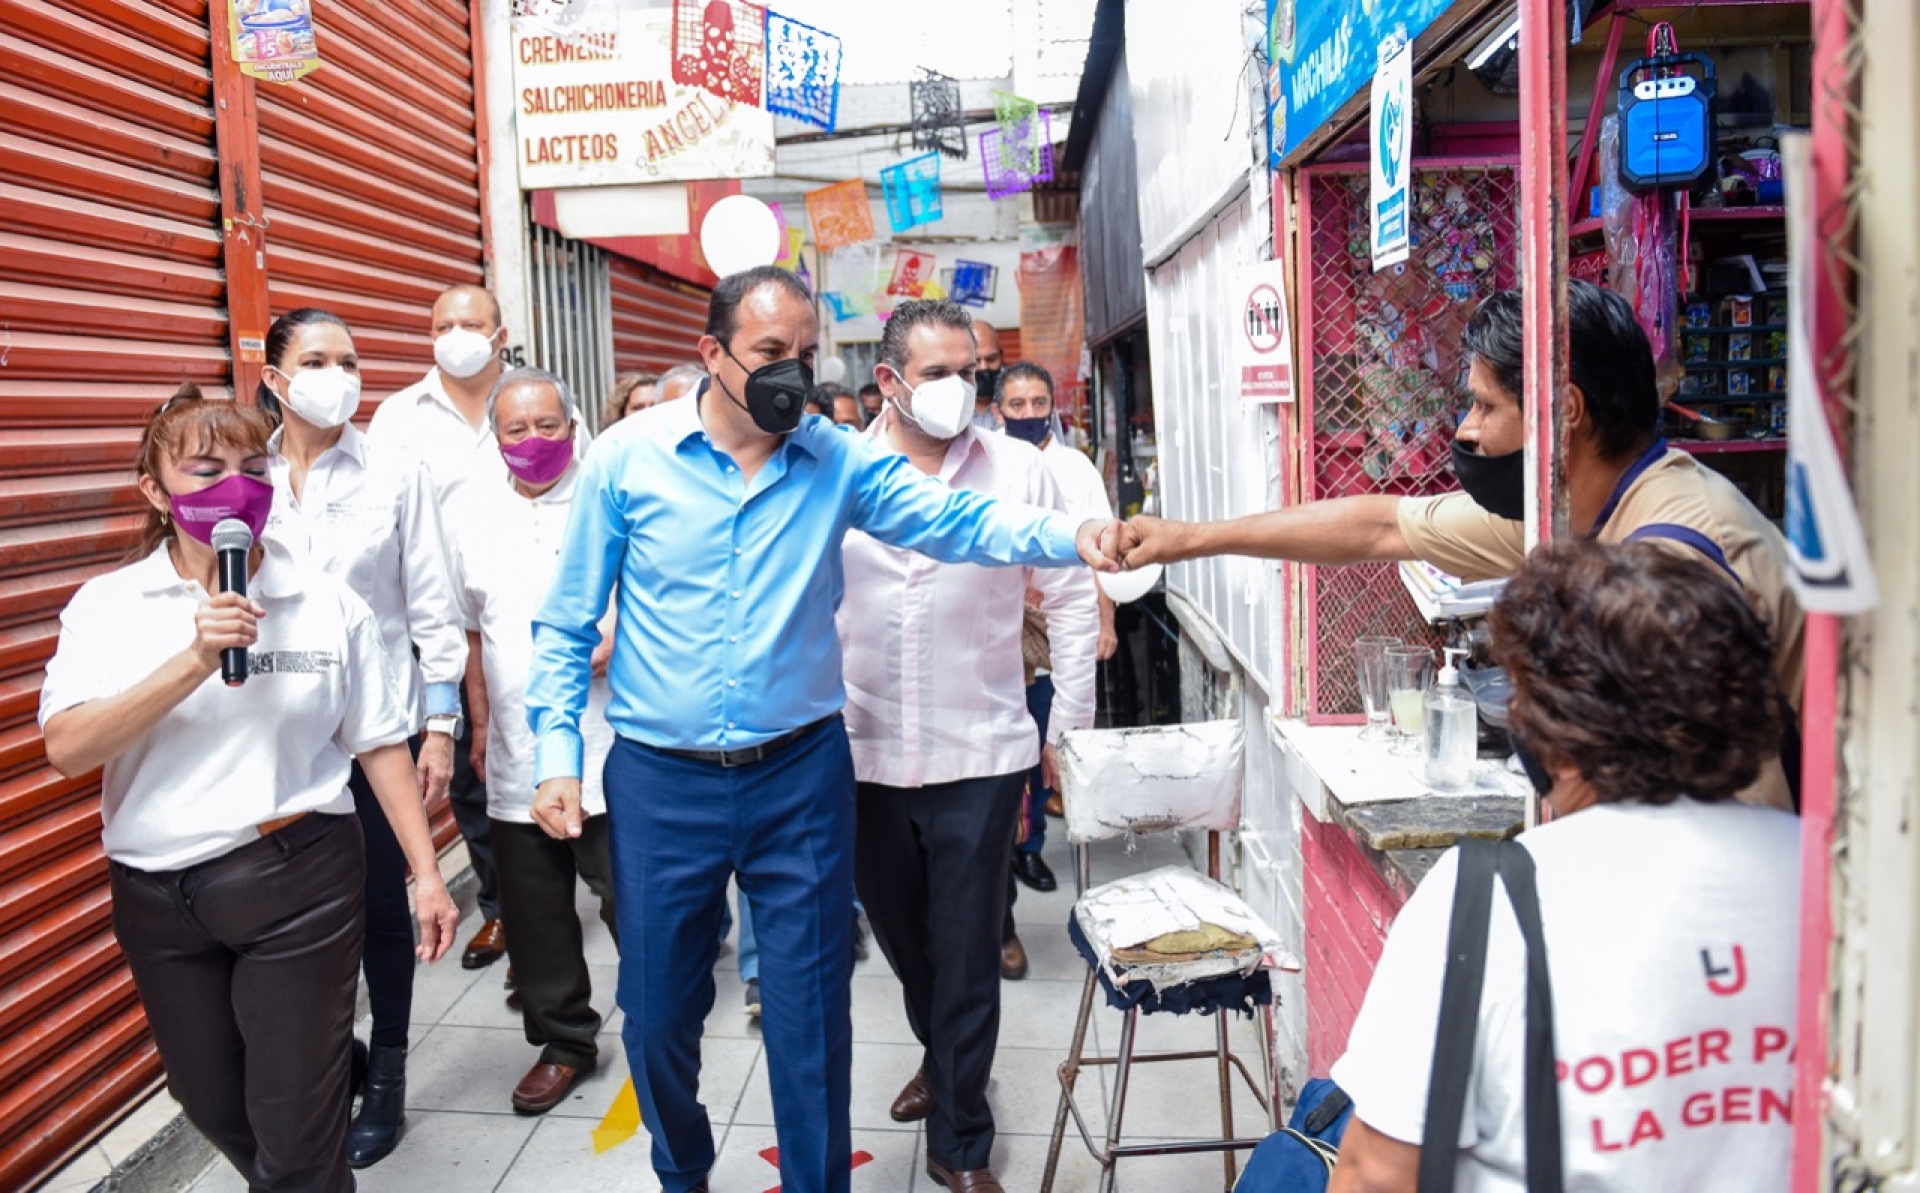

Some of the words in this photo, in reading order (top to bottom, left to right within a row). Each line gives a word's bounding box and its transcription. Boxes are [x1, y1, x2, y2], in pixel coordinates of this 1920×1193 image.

[1291, 14, 1352, 113] MOCHILAS
[523, 80, 667, 115] SALCHICHONERIA
[524, 134, 618, 164] LACTEOS
[1753, 1026, 1798, 1064] P
[1590, 1109, 1664, 1152] LA
